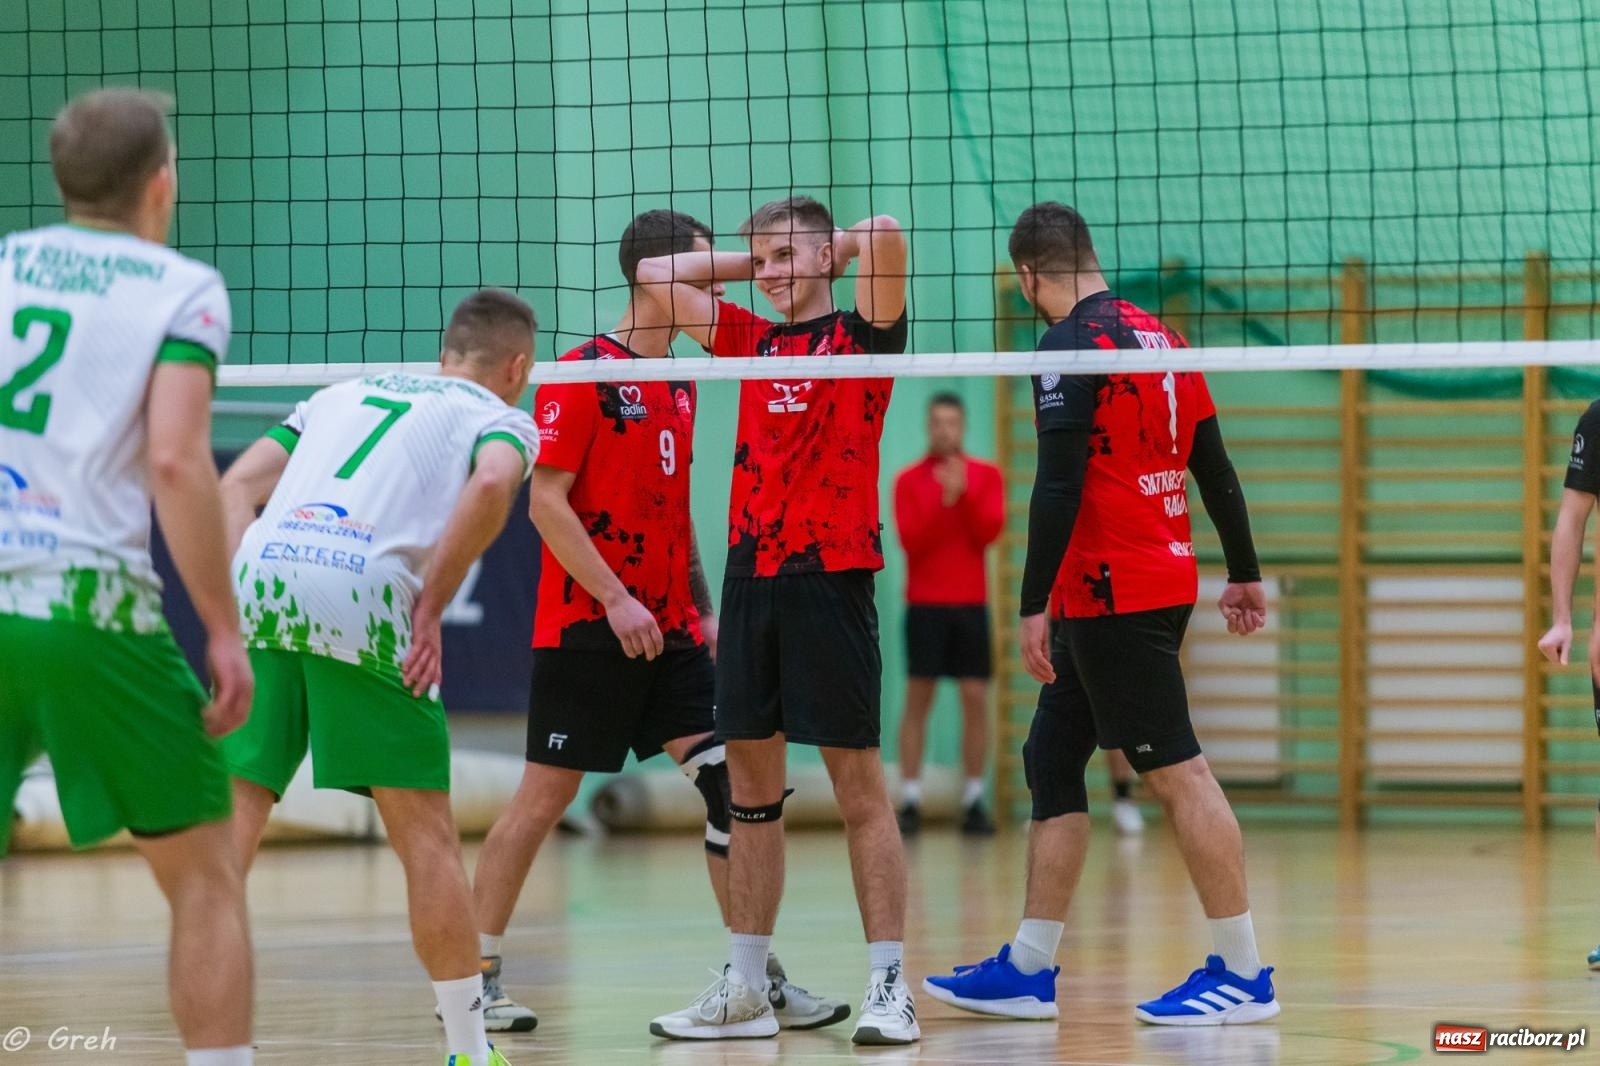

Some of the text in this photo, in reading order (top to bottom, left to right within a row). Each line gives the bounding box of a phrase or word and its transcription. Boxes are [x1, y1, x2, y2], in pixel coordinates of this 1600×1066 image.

[0, 304, 72, 436] 2
[620, 404, 648, 416] radlin
[334, 394, 413, 480] 7
[659, 429, 676, 476] 9
[260, 541, 366, 568] ENTECO
[728, 807, 767, 819] UELLER
